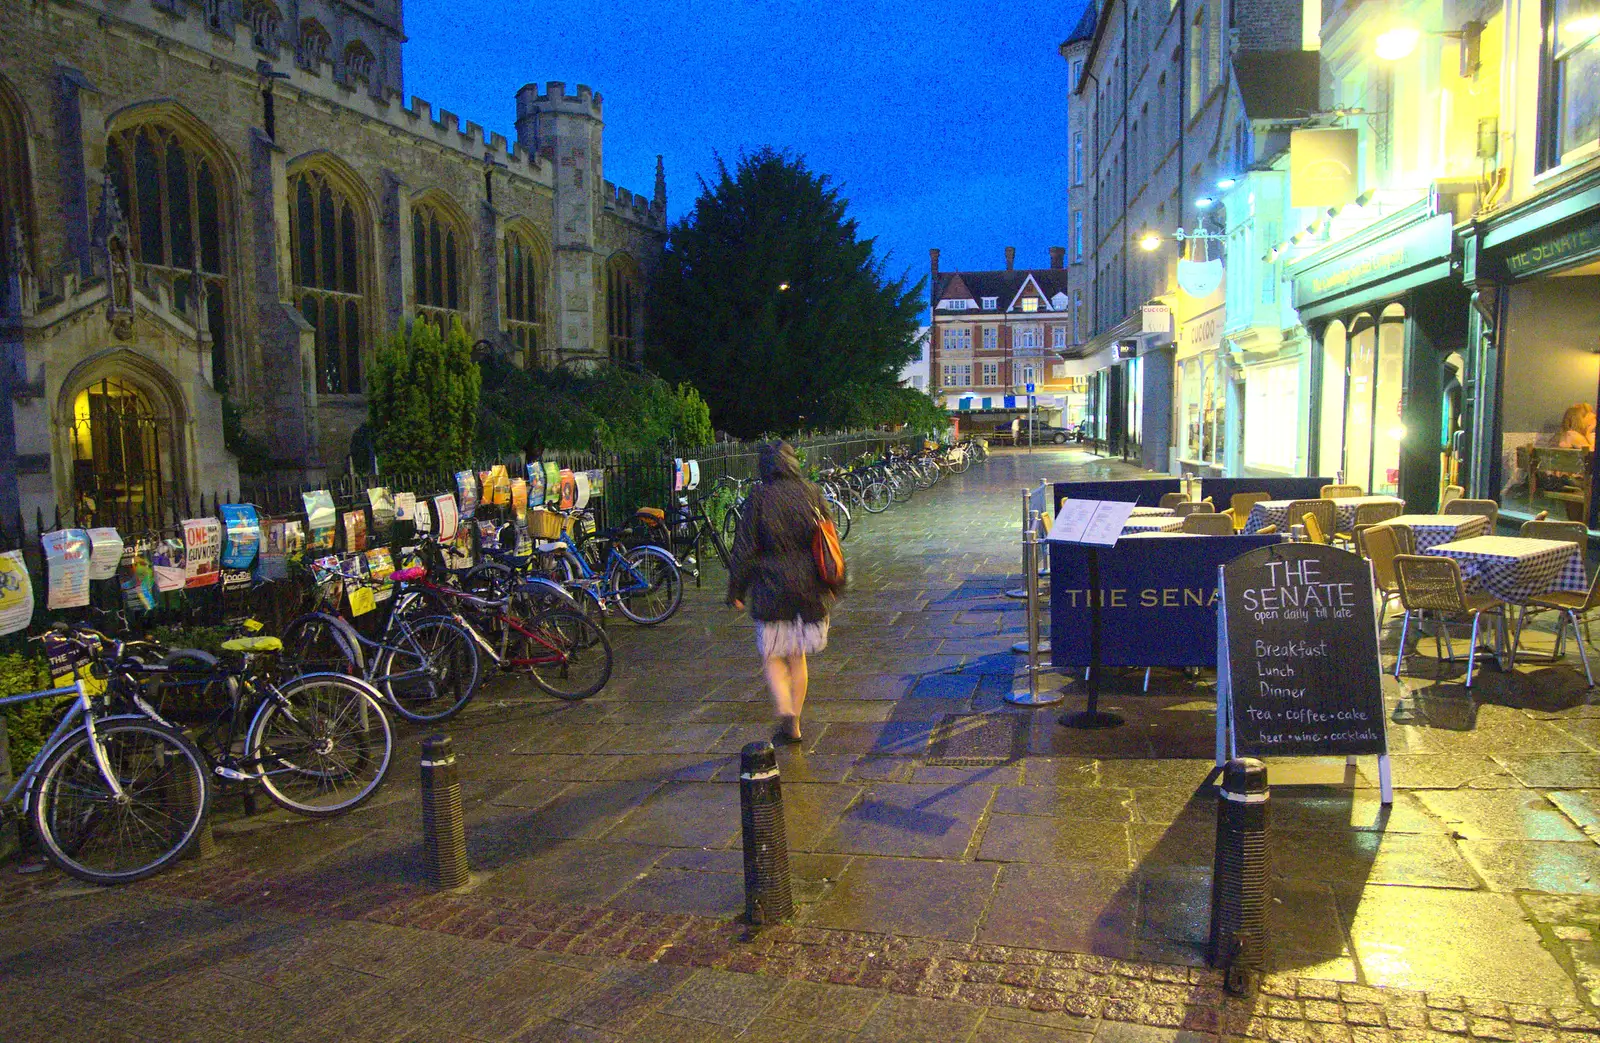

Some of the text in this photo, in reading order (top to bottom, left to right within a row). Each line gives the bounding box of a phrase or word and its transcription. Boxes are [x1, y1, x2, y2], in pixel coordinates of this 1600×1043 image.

[1531, 231, 1593, 261] SENATE
[1191, 318, 1216, 345] CUCKOO
[187, 526, 208, 547] ONE
[1265, 559, 1321, 587] THE
[1065, 588, 1127, 608] THE
[1243, 583, 1356, 612] SENATE
[1254, 606, 1354, 625] open daily till late
[1255, 639, 1329, 658] Breakfast
[49, 653, 68, 665] THE
[1257, 661, 1295, 677] Lunch
[1260, 681, 1307, 699] Dinner
[1246, 705, 1368, 724] tea coffee cake
[1259, 728, 1378, 743] beer wine cocktails
